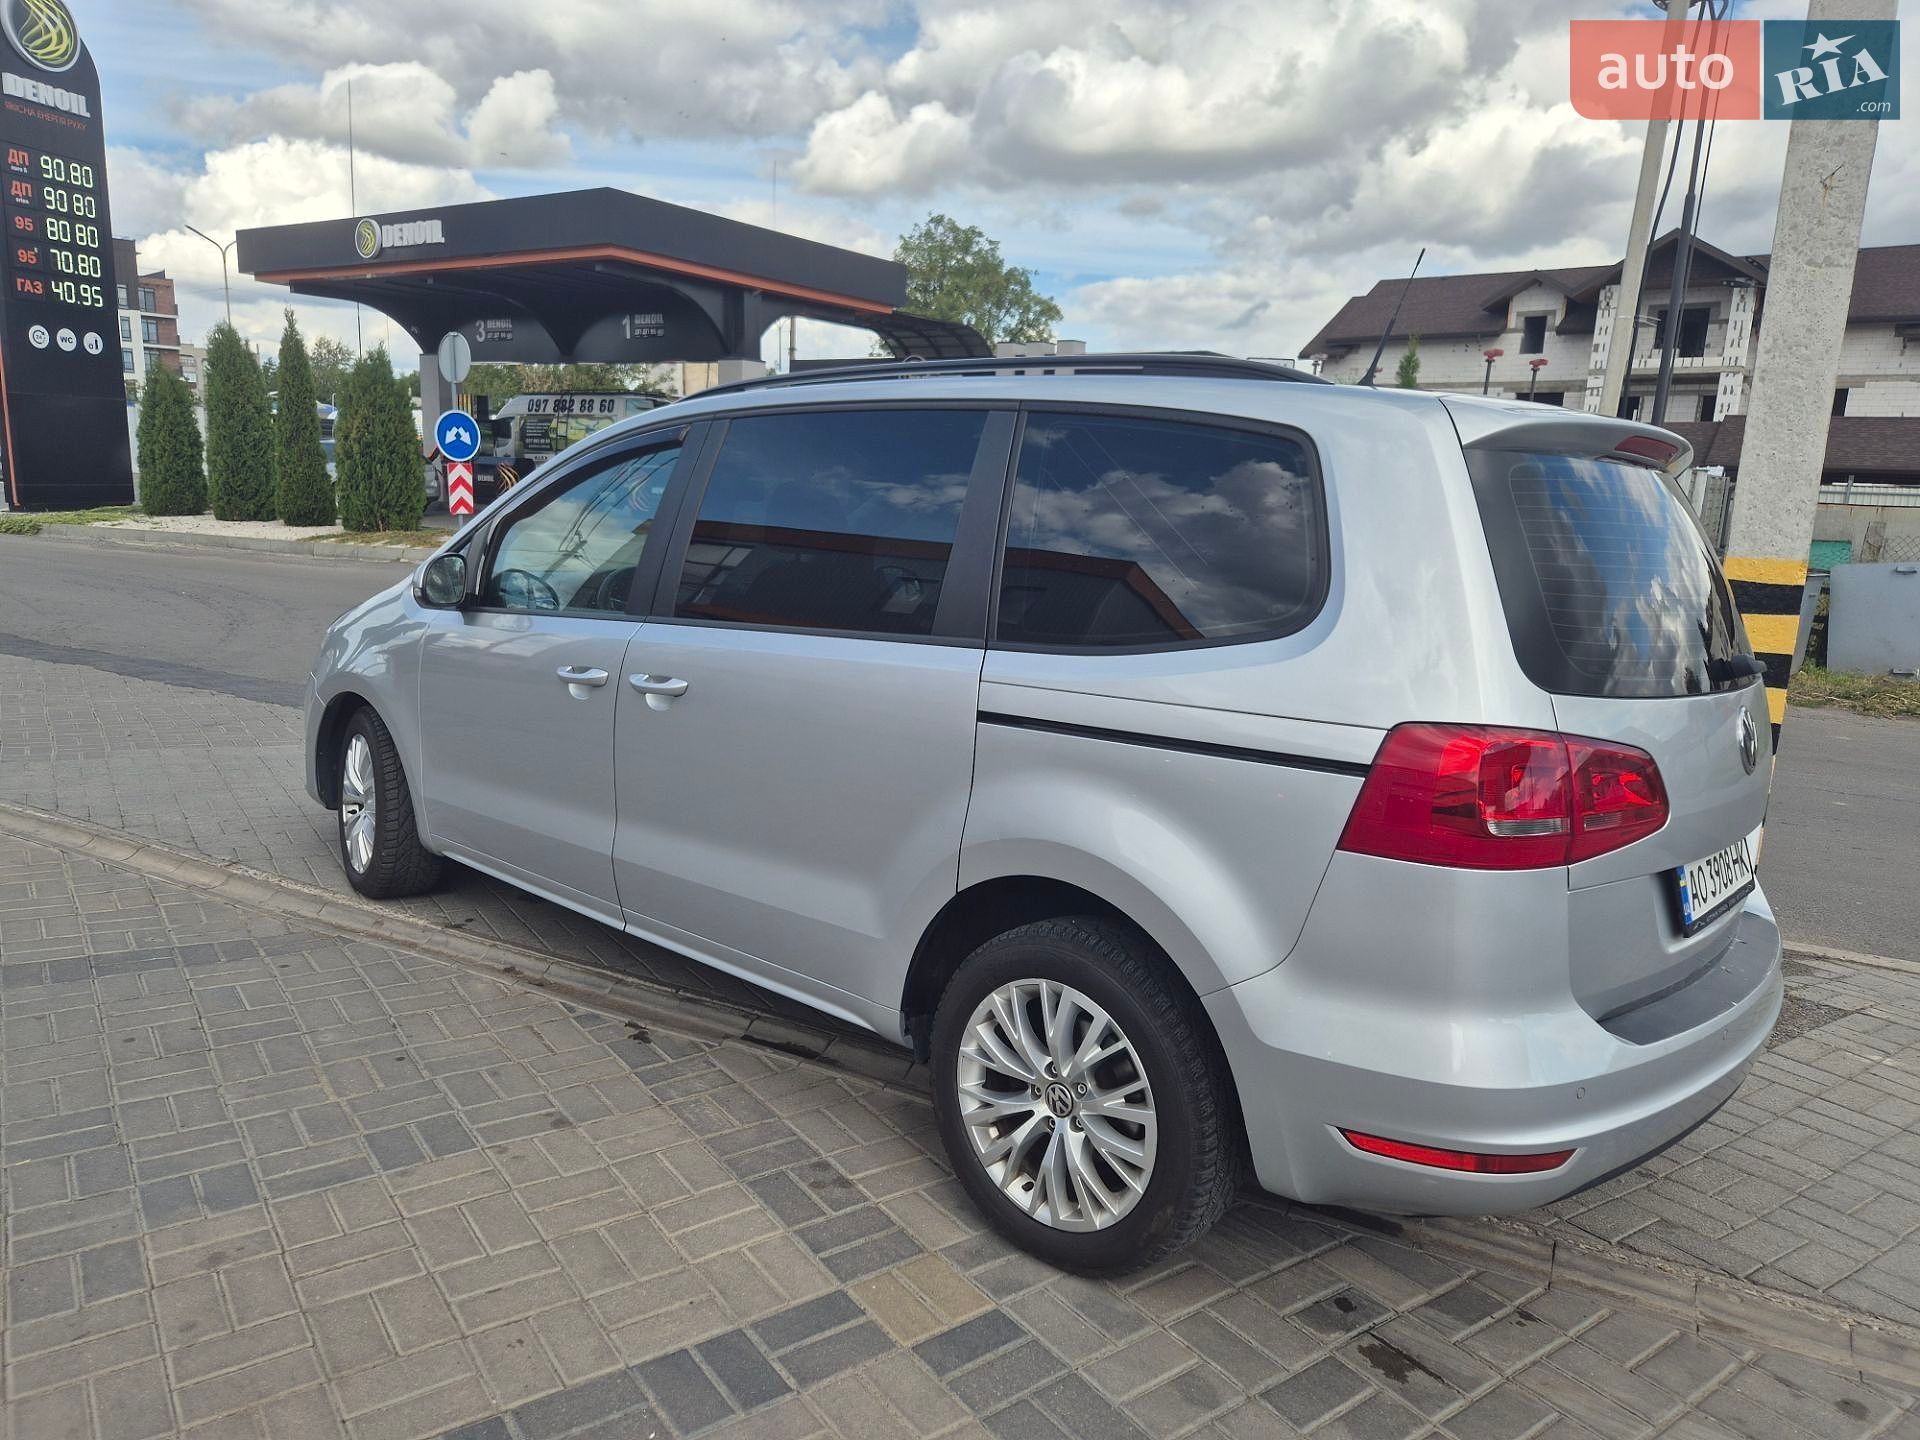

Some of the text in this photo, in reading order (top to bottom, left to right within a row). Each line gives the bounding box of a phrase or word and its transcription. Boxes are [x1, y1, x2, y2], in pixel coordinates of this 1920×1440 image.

[8, 148, 93, 188] ДП 90.80
[11, 180, 32, 197] ДП
[15, 216, 34, 231] 95
[49, 248, 101, 278] 70.80
[16, 278, 103, 307] ГАЗ 40.95
[60, 335, 73, 344] WC
[476, 319, 486, 342] 3
[527, 398, 549, 413] 097
[579, 398, 595, 413] 88
[599, 398, 615, 413] 60
[1689, 864, 1708, 912] AO
[1705, 847, 1734, 898] 3908
